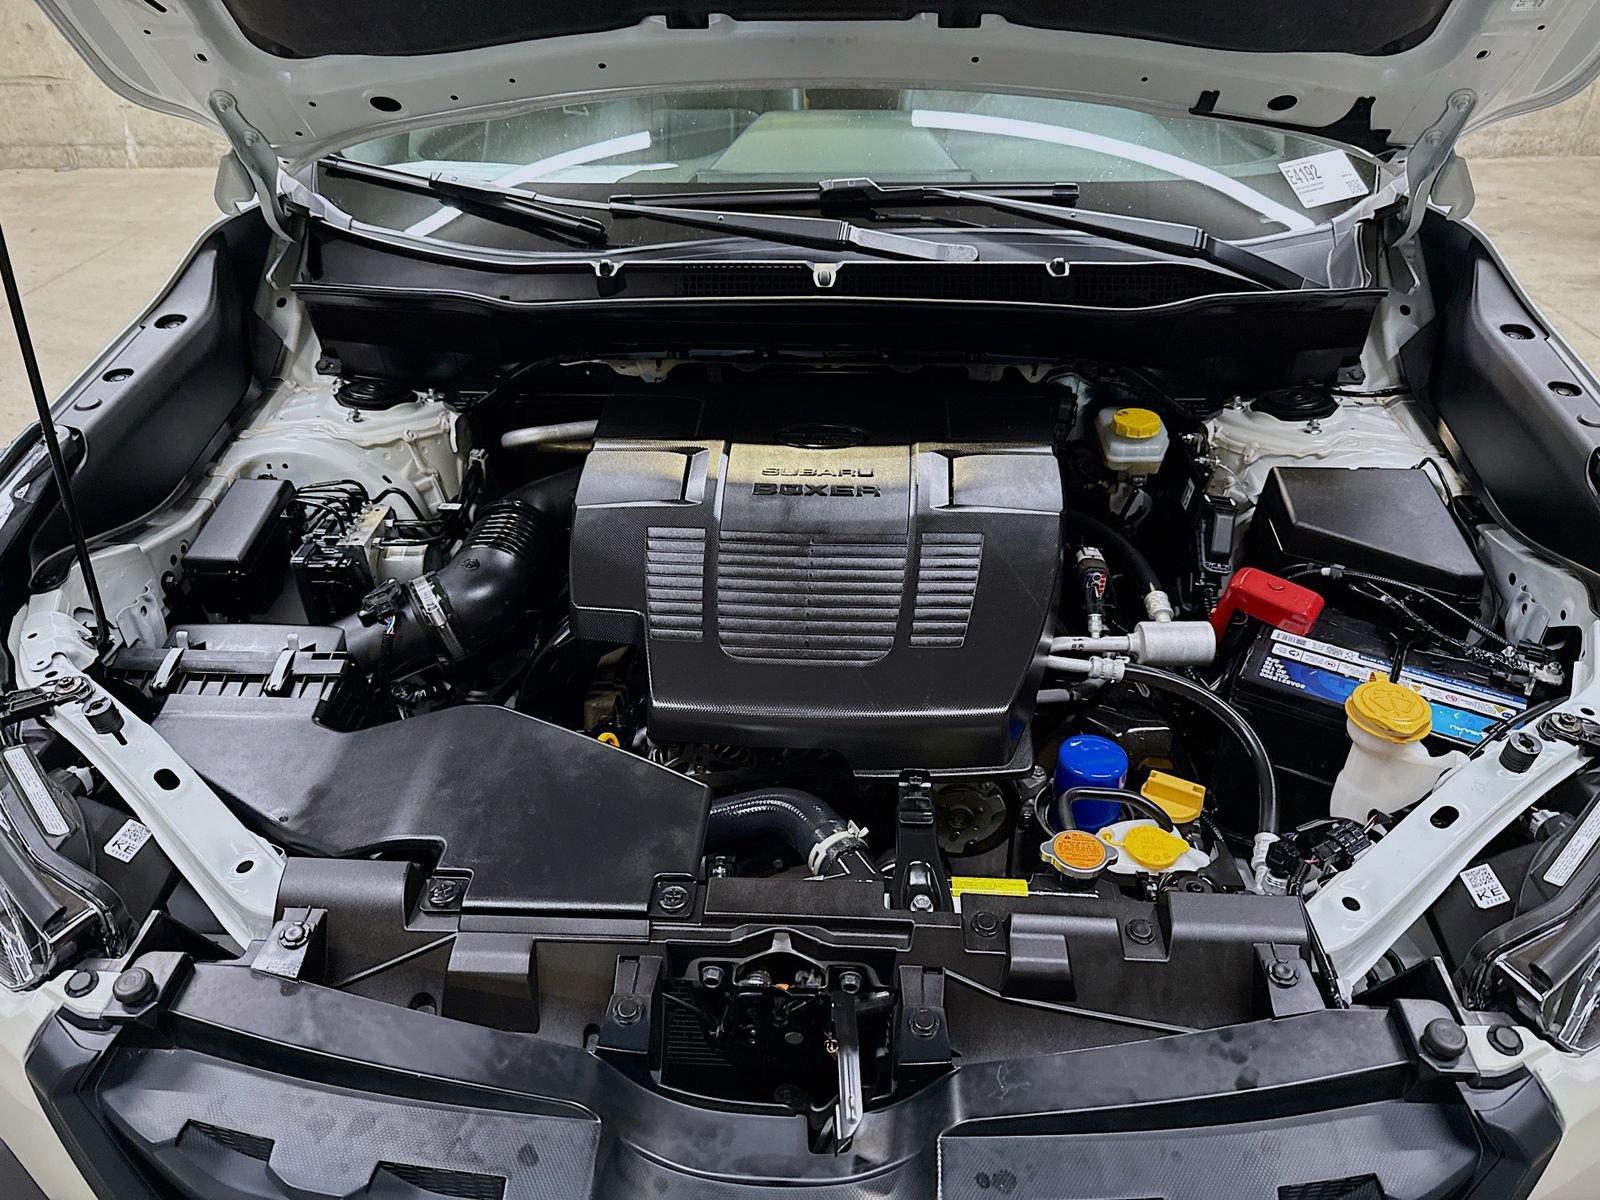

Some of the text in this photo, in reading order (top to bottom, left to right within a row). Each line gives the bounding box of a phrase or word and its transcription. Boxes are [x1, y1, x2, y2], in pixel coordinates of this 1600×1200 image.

[1285, 164, 1322, 185] E4192
[762, 467, 874, 477] SUBARU
[752, 483, 881, 497] BOXER
[112, 840, 136, 855] KE
[1477, 886, 1503, 901] KE
